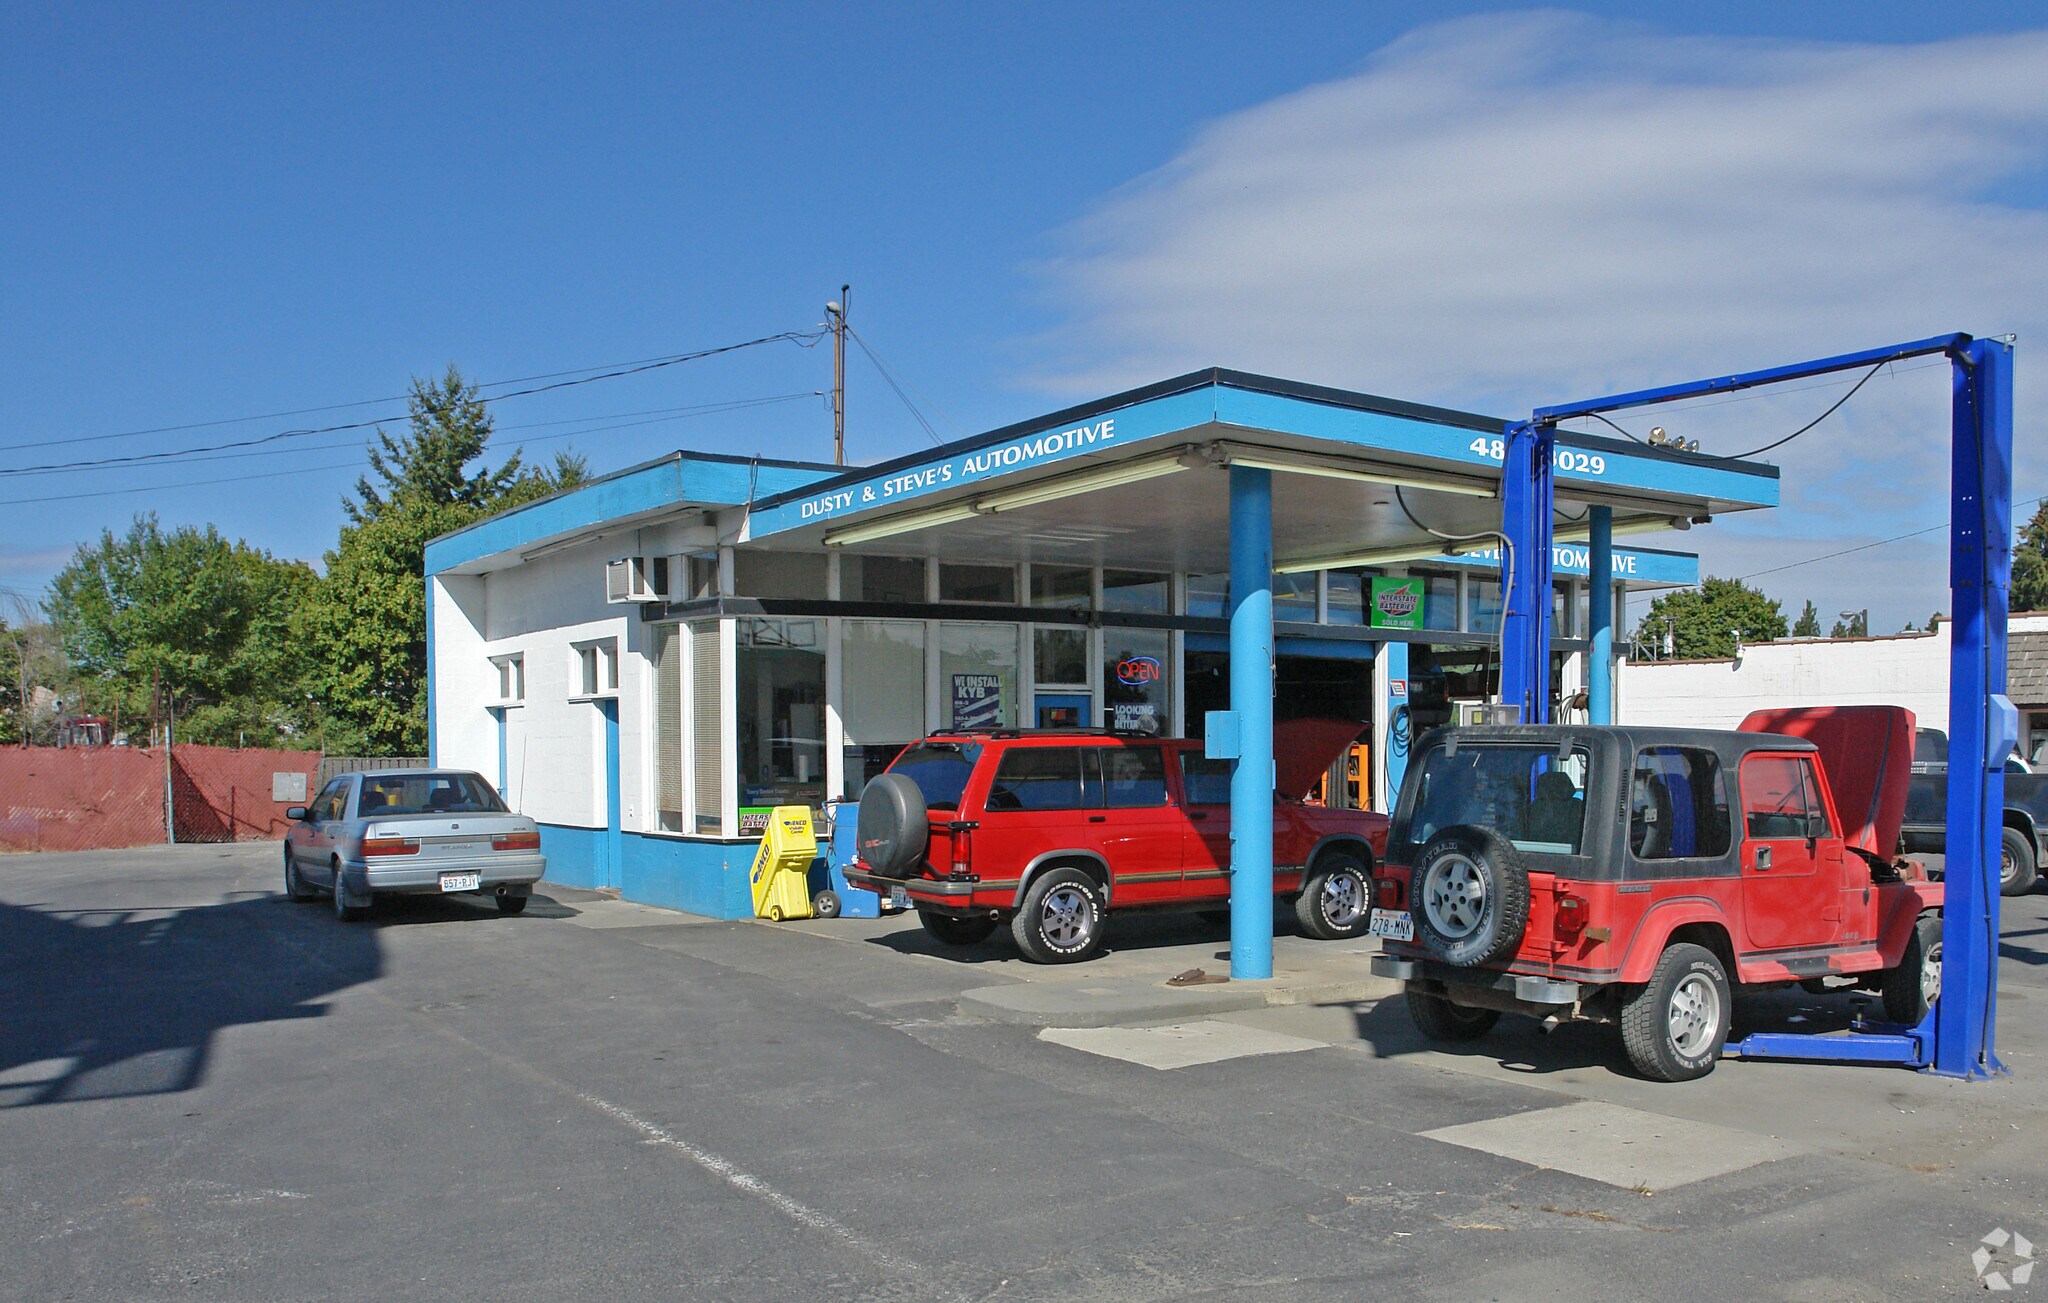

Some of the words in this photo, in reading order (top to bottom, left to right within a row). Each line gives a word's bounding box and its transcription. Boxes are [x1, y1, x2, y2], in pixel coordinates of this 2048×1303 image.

[801, 491, 854, 518] DUSTY
[862, 486, 877, 502] &
[883, 464, 952, 497] STEVE'S
[961, 419, 1115, 476] AUTOMOTIVE
[1379, 593, 1418, 603] INTERSTATE
[1379, 602, 1415, 611] BATTERIES
[1117, 661, 1159, 680] OPEN
[954, 676, 965, 687] WE
[966, 676, 1003, 688] INSTALL
[958, 687, 986, 699] KYB
[1115, 705, 1154, 715] LOOKING
[1413, 842, 1458, 908] GOODYEAR
[1371, 918, 1412, 935] 278-MNK
[1038, 925, 1064, 954] RADIAL
[1065, 936, 1091, 954] STEEL
[1690, 961, 1723, 981] WILDCAT
